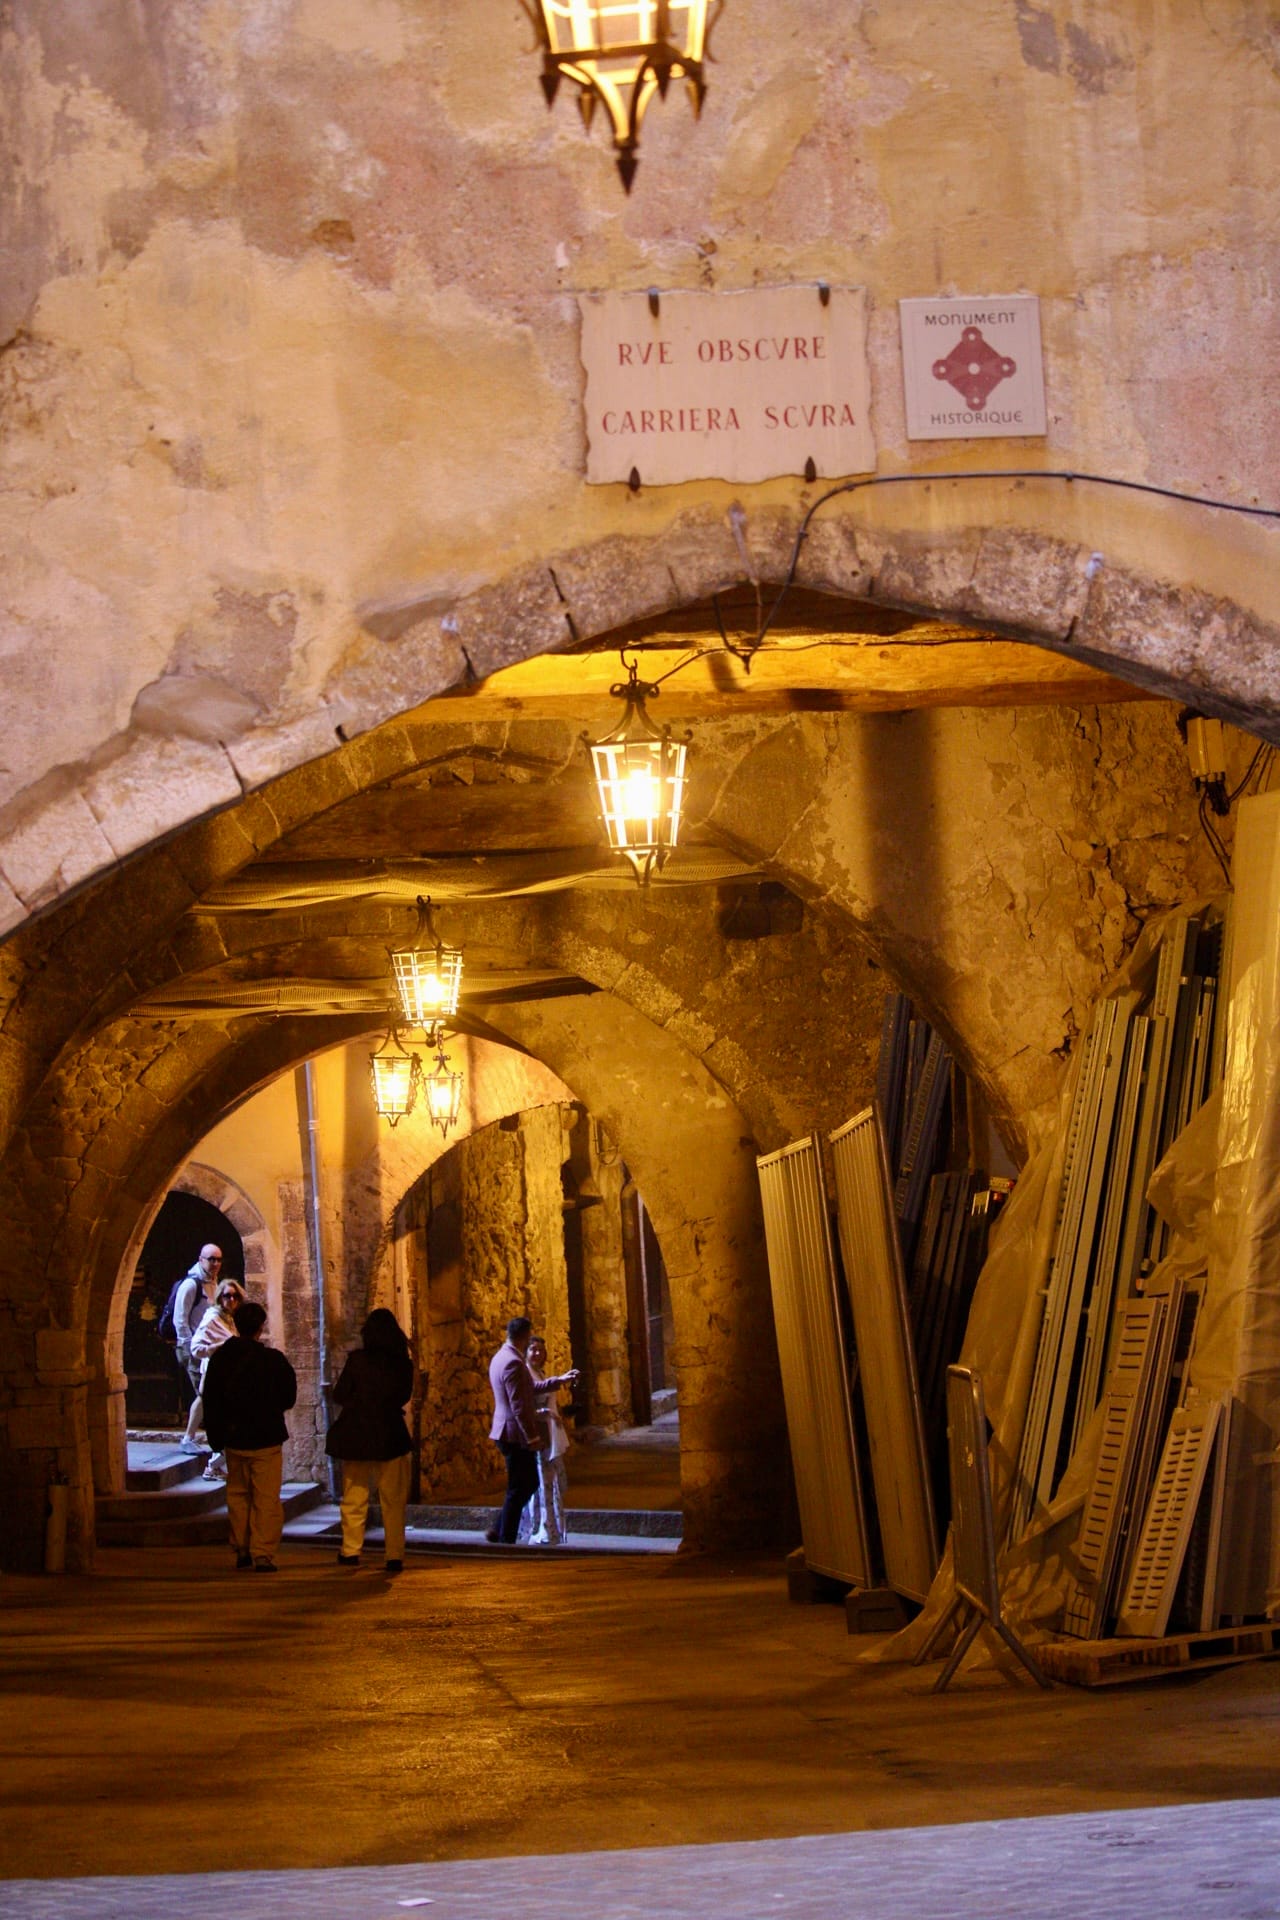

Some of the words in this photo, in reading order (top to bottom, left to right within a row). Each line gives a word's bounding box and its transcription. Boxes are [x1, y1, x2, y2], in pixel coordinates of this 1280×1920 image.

[924, 312, 1016, 326] MONUMENT
[618, 341, 674, 366] RVE
[697, 336, 826, 363] OBSCVRE
[602, 407, 741, 435] CARRIERA
[764, 403, 856, 430] SCVRA
[930, 410, 1024, 425] HISTORIQUE
